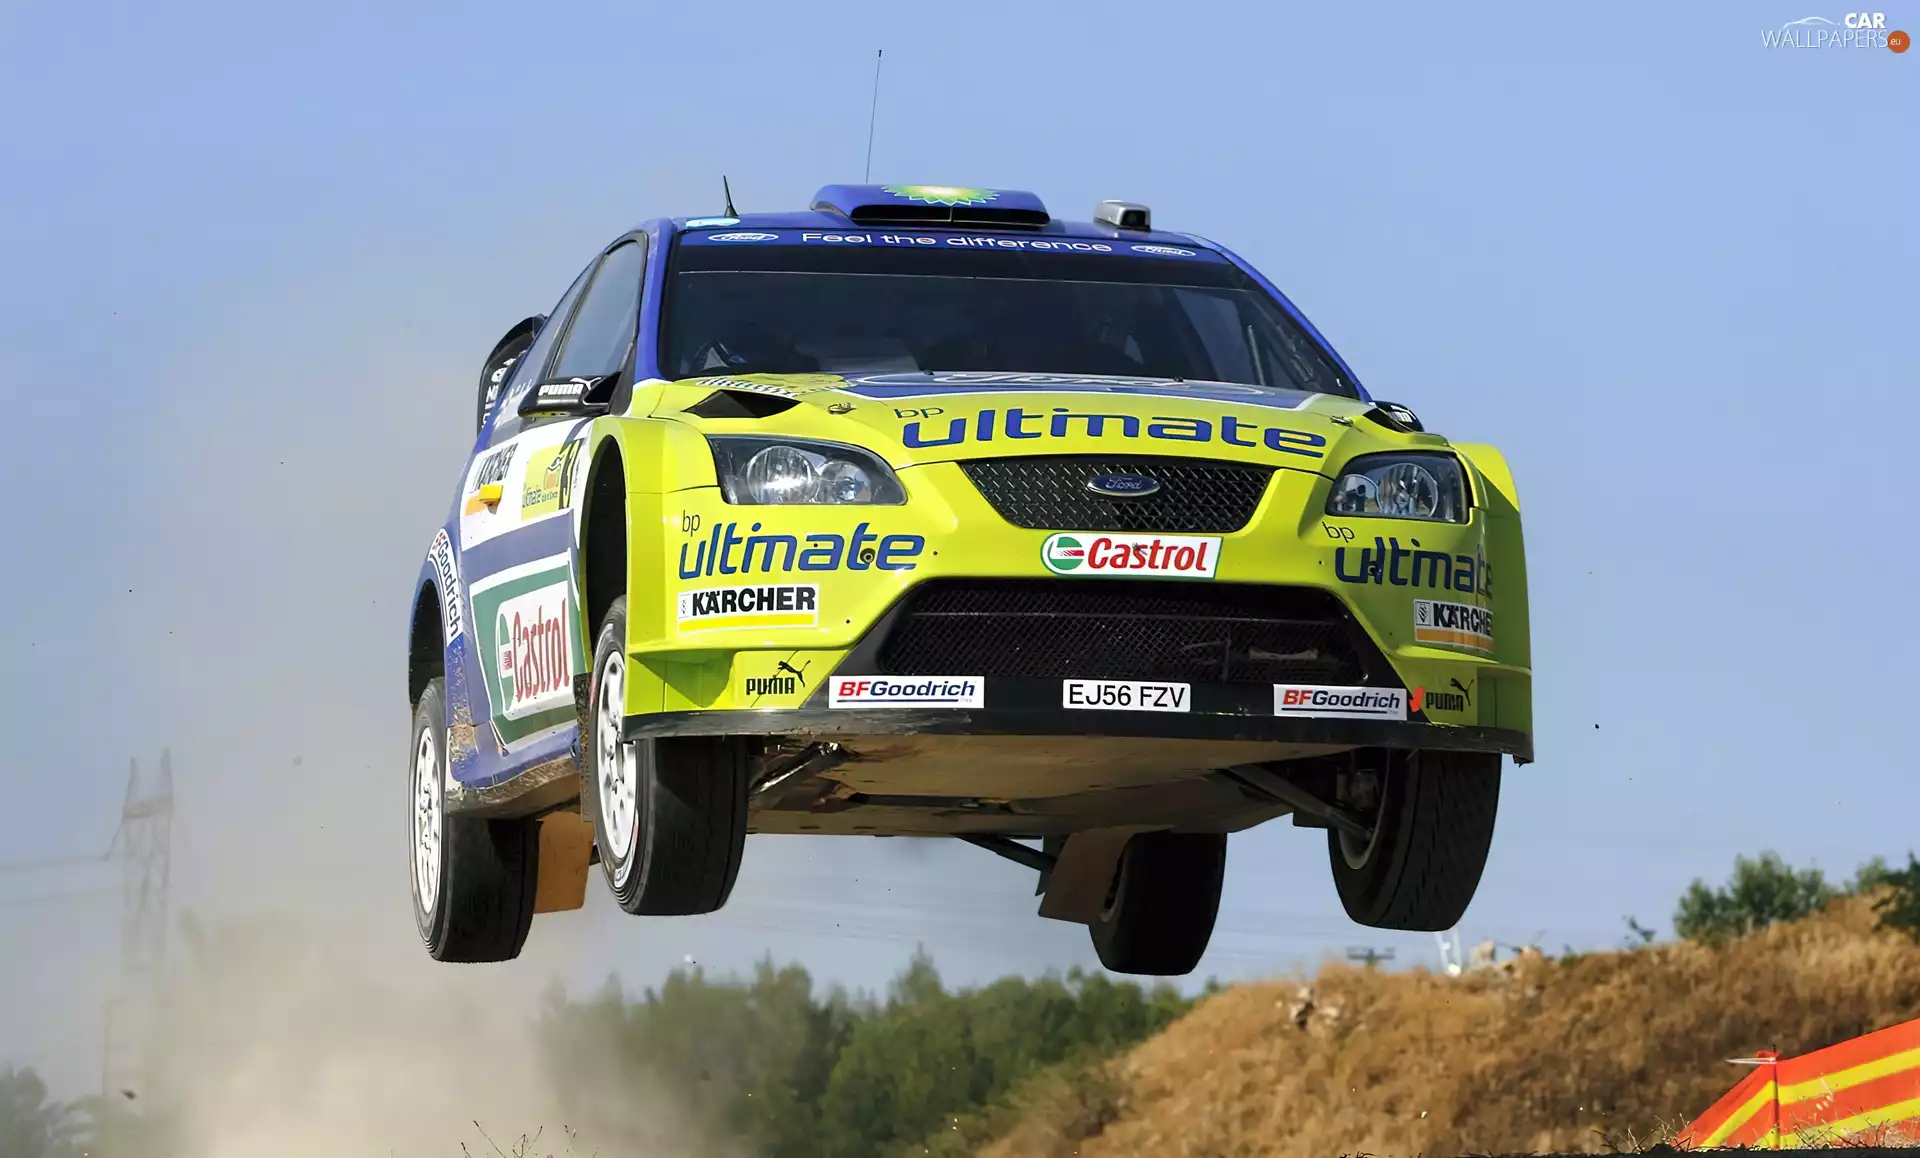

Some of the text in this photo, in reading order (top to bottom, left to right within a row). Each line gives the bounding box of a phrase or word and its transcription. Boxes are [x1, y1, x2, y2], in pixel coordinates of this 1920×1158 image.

[802, 232, 1112, 252] Feel the difference
[538, 383, 584, 396] PUMA
[894, 407, 945, 421] bp
[902, 407, 1327, 459] ultimate
[1105, 477, 1143, 489] Ford
[682, 510, 700, 536] bp
[1322, 521, 1355, 543] bp
[679, 522, 925, 579] ultimate
[1088, 537, 1207, 572] Castrol
[692, 586, 816, 616] KÄRCHER
[1433, 603, 1493, 637] KÄRCHE
[512, 598, 570, 702] Castrol
[746, 677, 795, 695] PUMA
[838, 679, 975, 697] BFGoodrich
[1069, 684, 1186, 709] EJ56 FZV
[1283, 689, 1400, 709] BFGoodrich
[1426, 692, 1464, 712] PUMA
